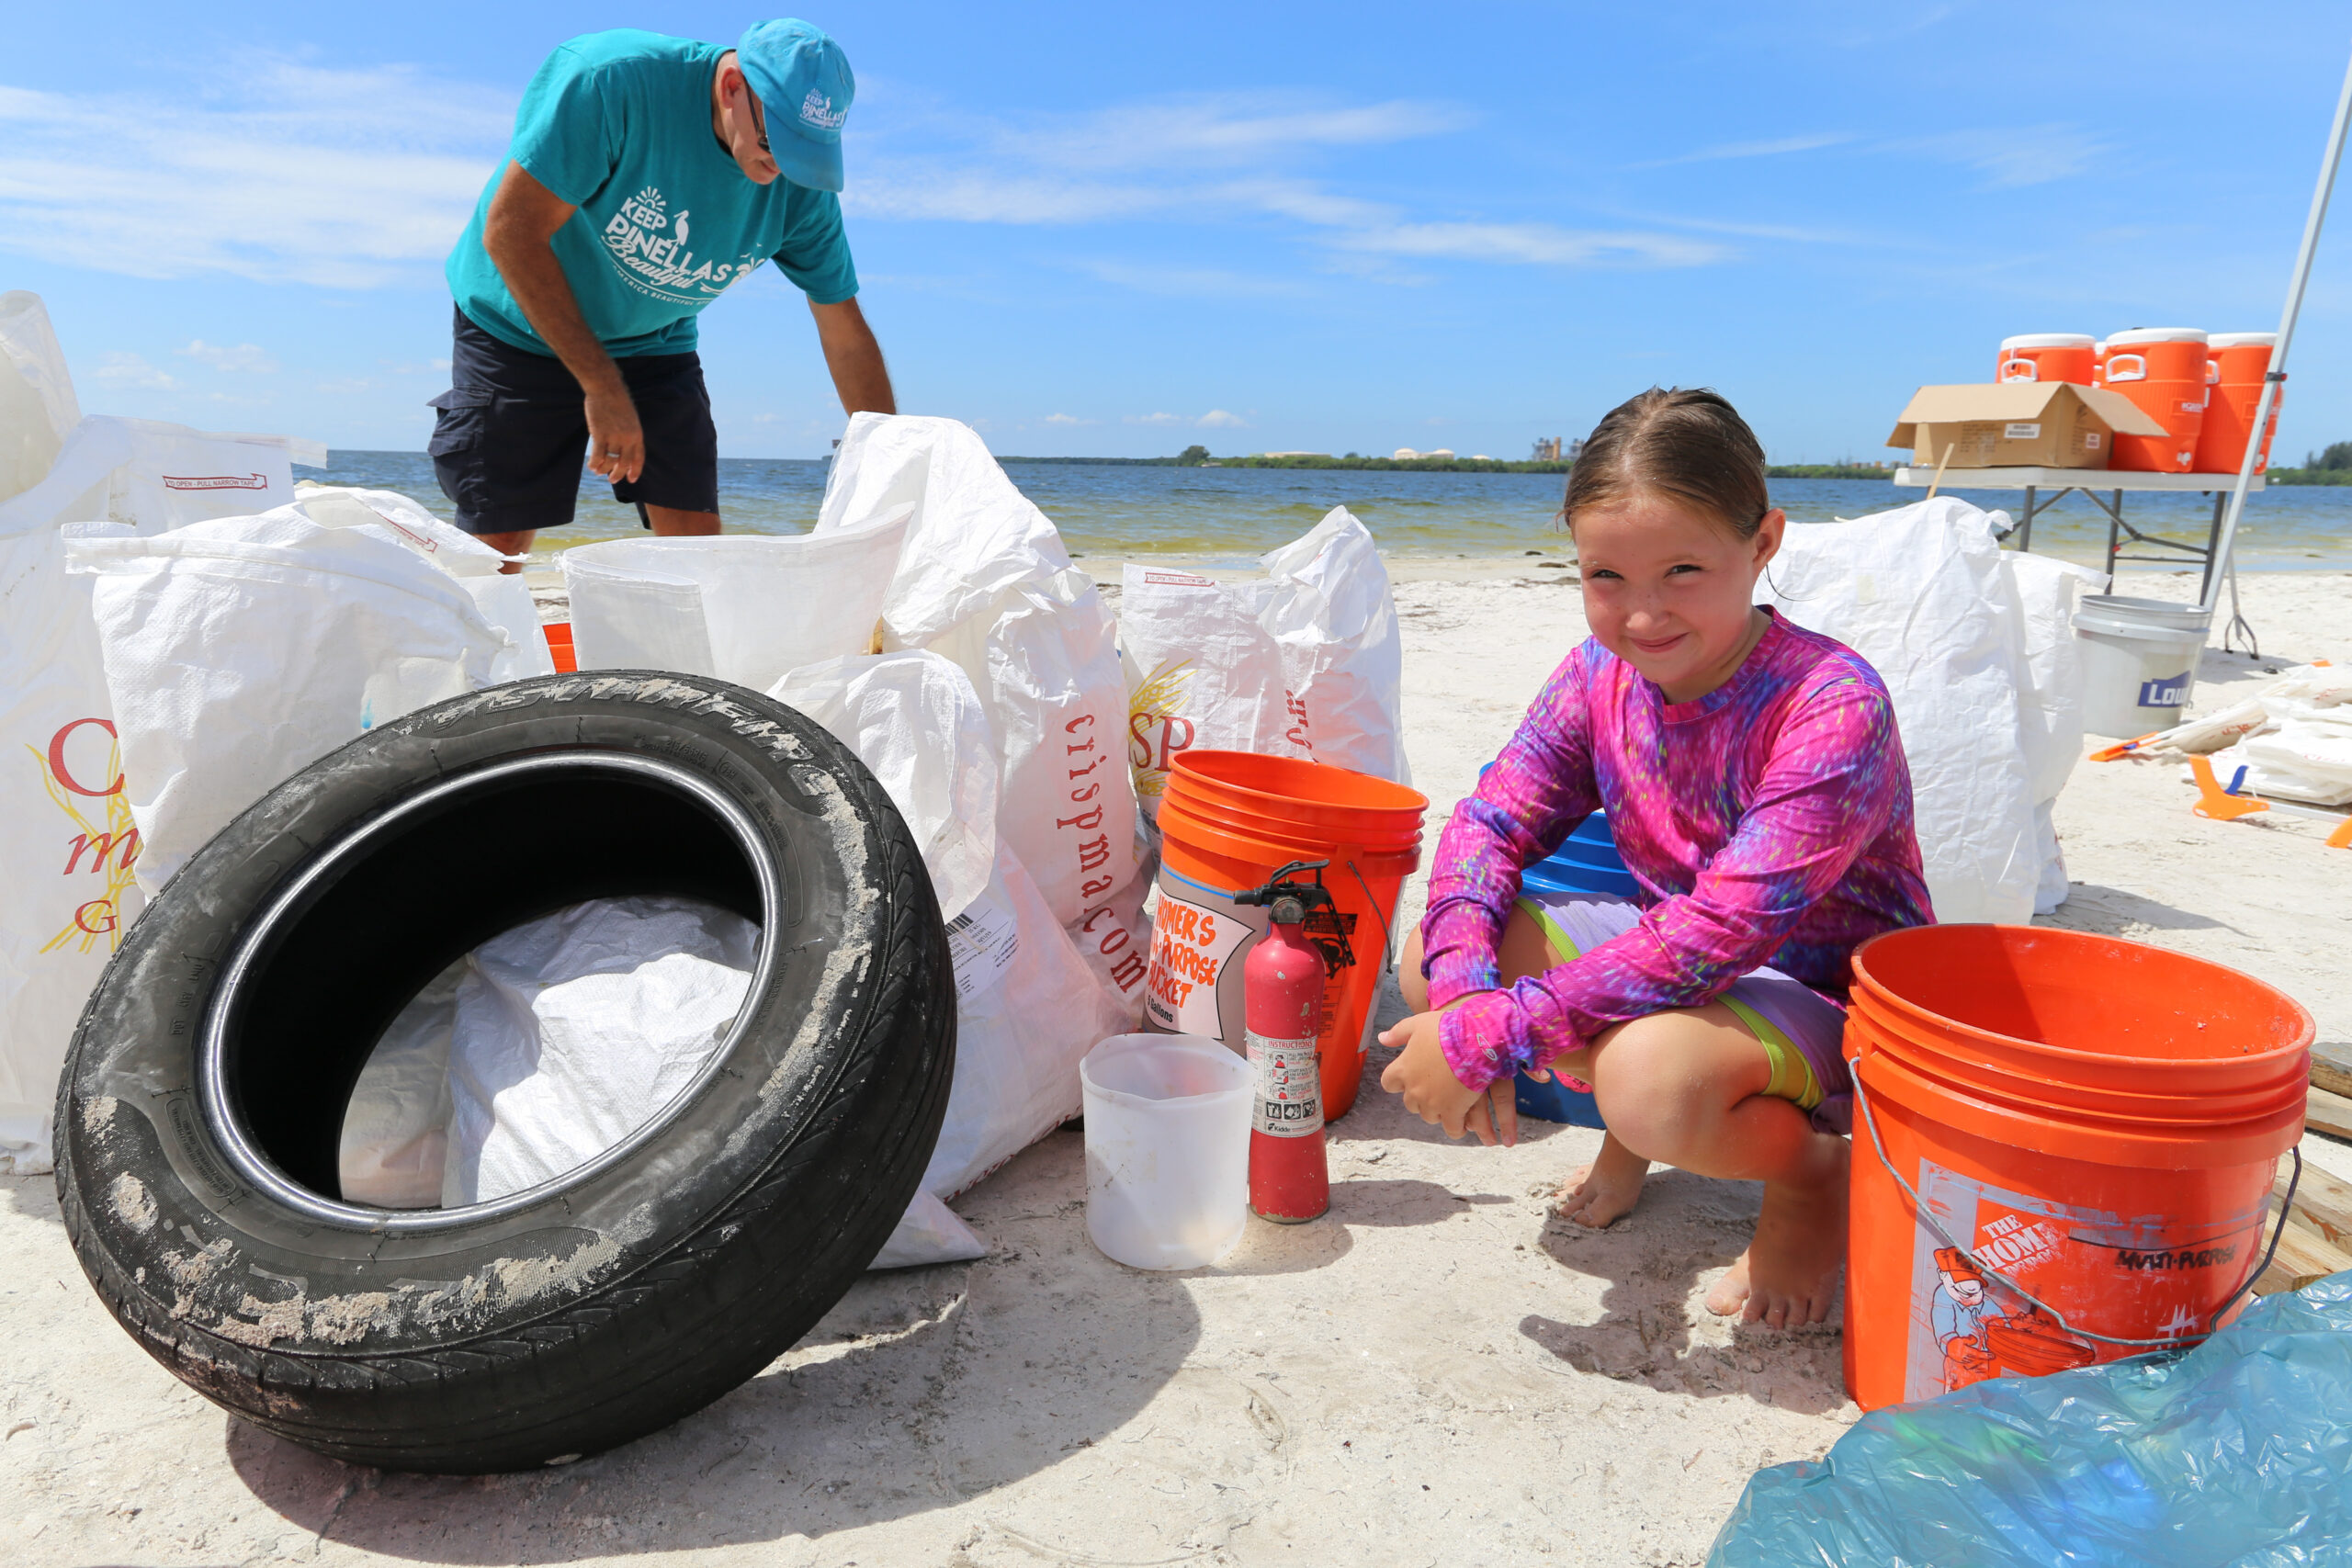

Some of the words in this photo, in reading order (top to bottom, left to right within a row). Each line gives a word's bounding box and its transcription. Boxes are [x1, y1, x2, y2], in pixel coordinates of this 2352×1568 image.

[802, 101, 842, 121] PINELLAS
[806, 94, 823, 106] KEEP
[620, 197, 668, 231] KEEP
[601, 235, 704, 289] Beautiful
[605, 212, 732, 283] PINELLAS
[1156, 894, 1216, 947] HOMER'S
[1148, 960, 1193, 1009] BUCKET
[1150, 998, 1174, 1023] Gallons
[1268, 1040, 1314, 1049] INSTRUCTIONS
[1274, 1124, 1291, 1133] Kidde
[1981, 1214, 2024, 1239] THE
[1971, 1222, 2067, 1271] HOME
